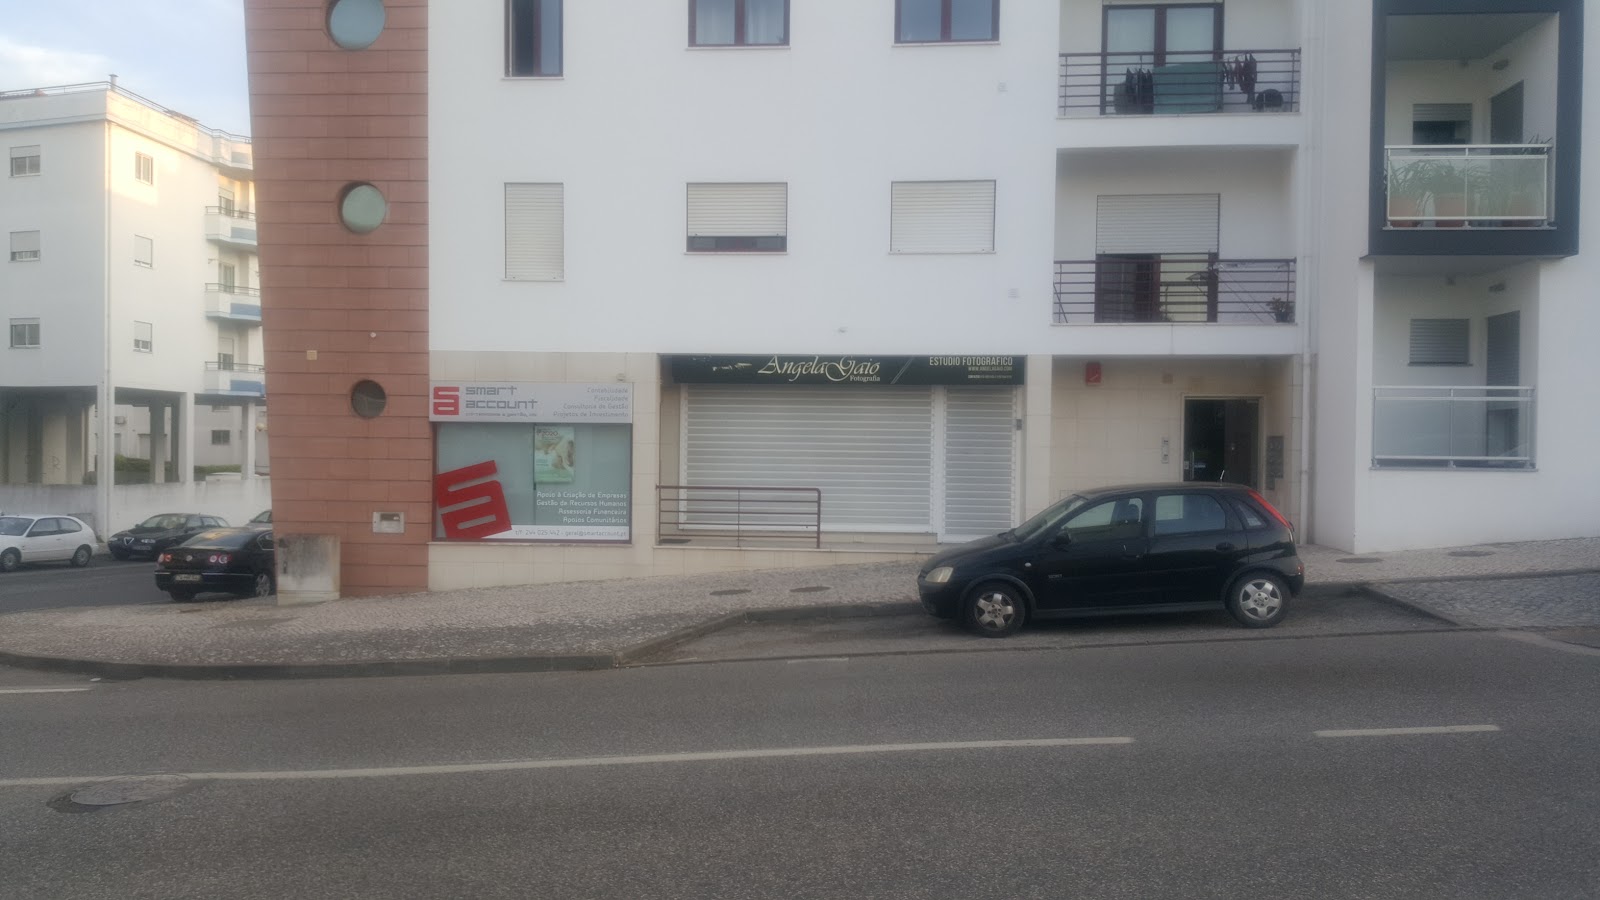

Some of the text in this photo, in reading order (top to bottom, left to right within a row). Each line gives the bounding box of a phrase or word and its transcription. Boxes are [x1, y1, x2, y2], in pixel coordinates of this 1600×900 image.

[465, 385, 517, 395] smart
[465, 398, 538, 409] account
[607, 402, 629, 410] Gestão
[536, 491, 556, 499] Apoio
[563, 491, 586, 499] Criação
[563, 516, 585, 524] Apoios
